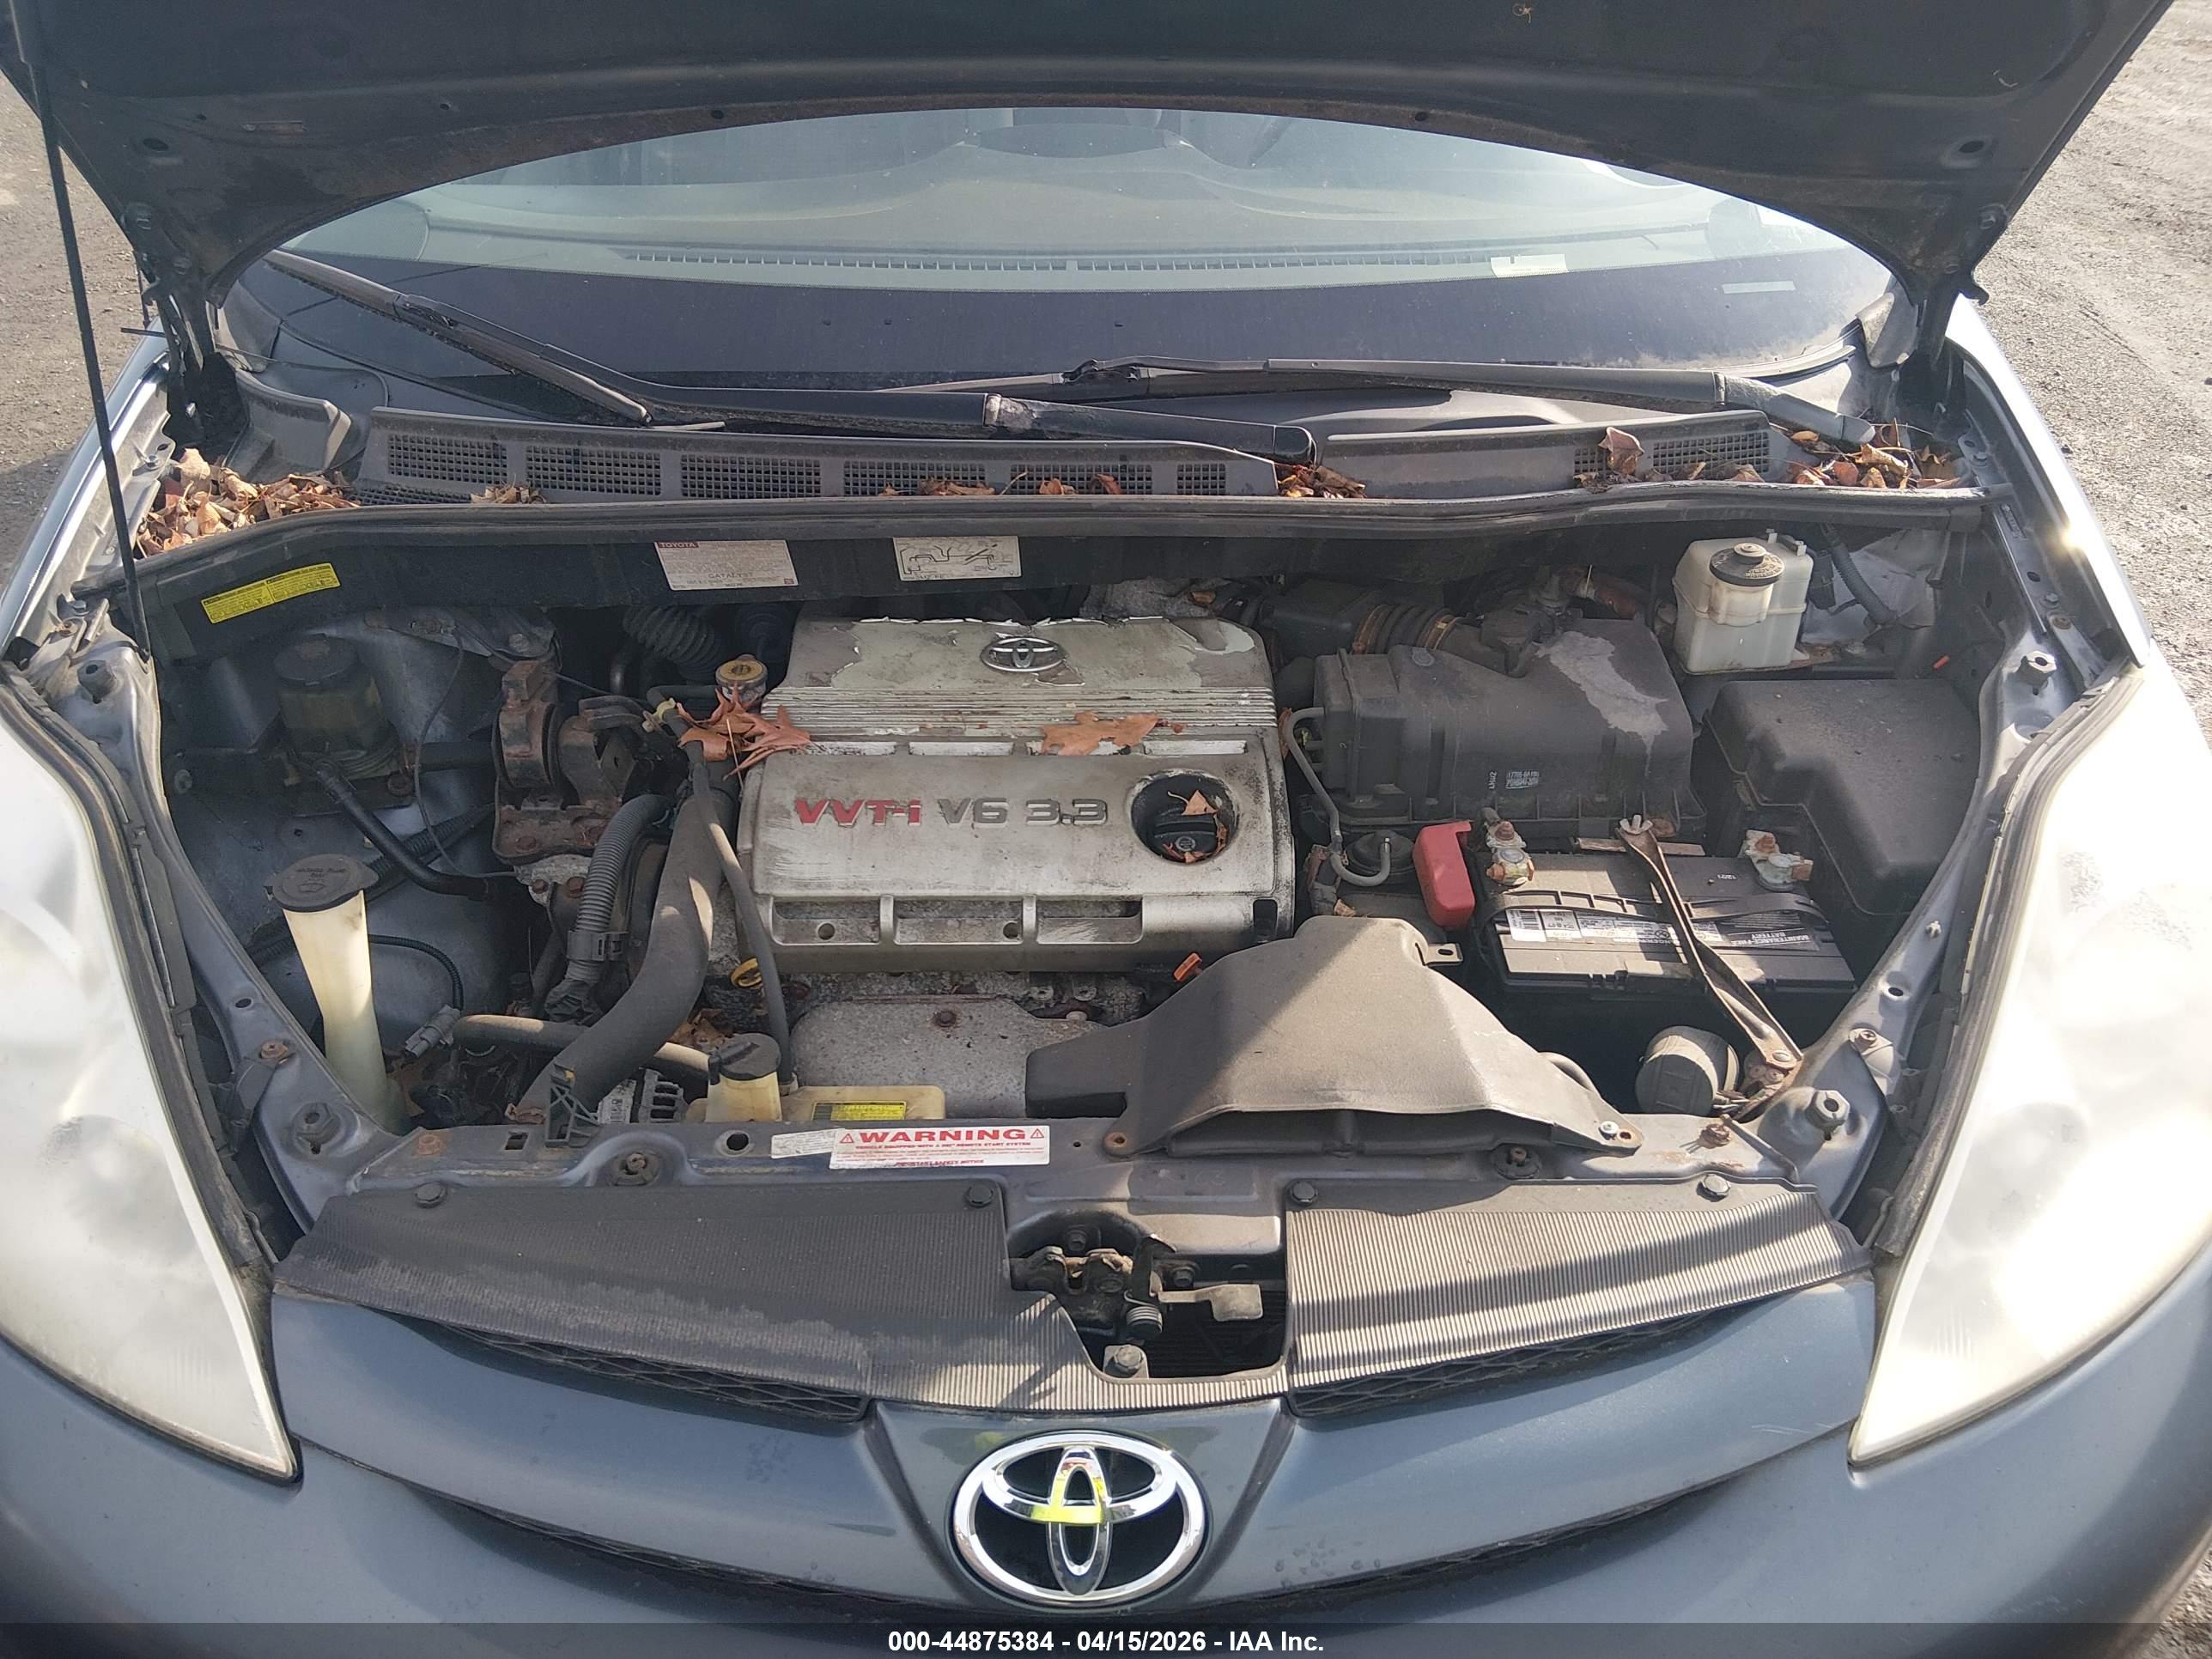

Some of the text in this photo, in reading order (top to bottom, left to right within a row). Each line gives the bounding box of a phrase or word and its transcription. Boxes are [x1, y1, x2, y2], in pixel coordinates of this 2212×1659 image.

[795, 798, 1108, 826] VVT-i V6 3.3
[859, 1128, 1026, 1143] WARNING
